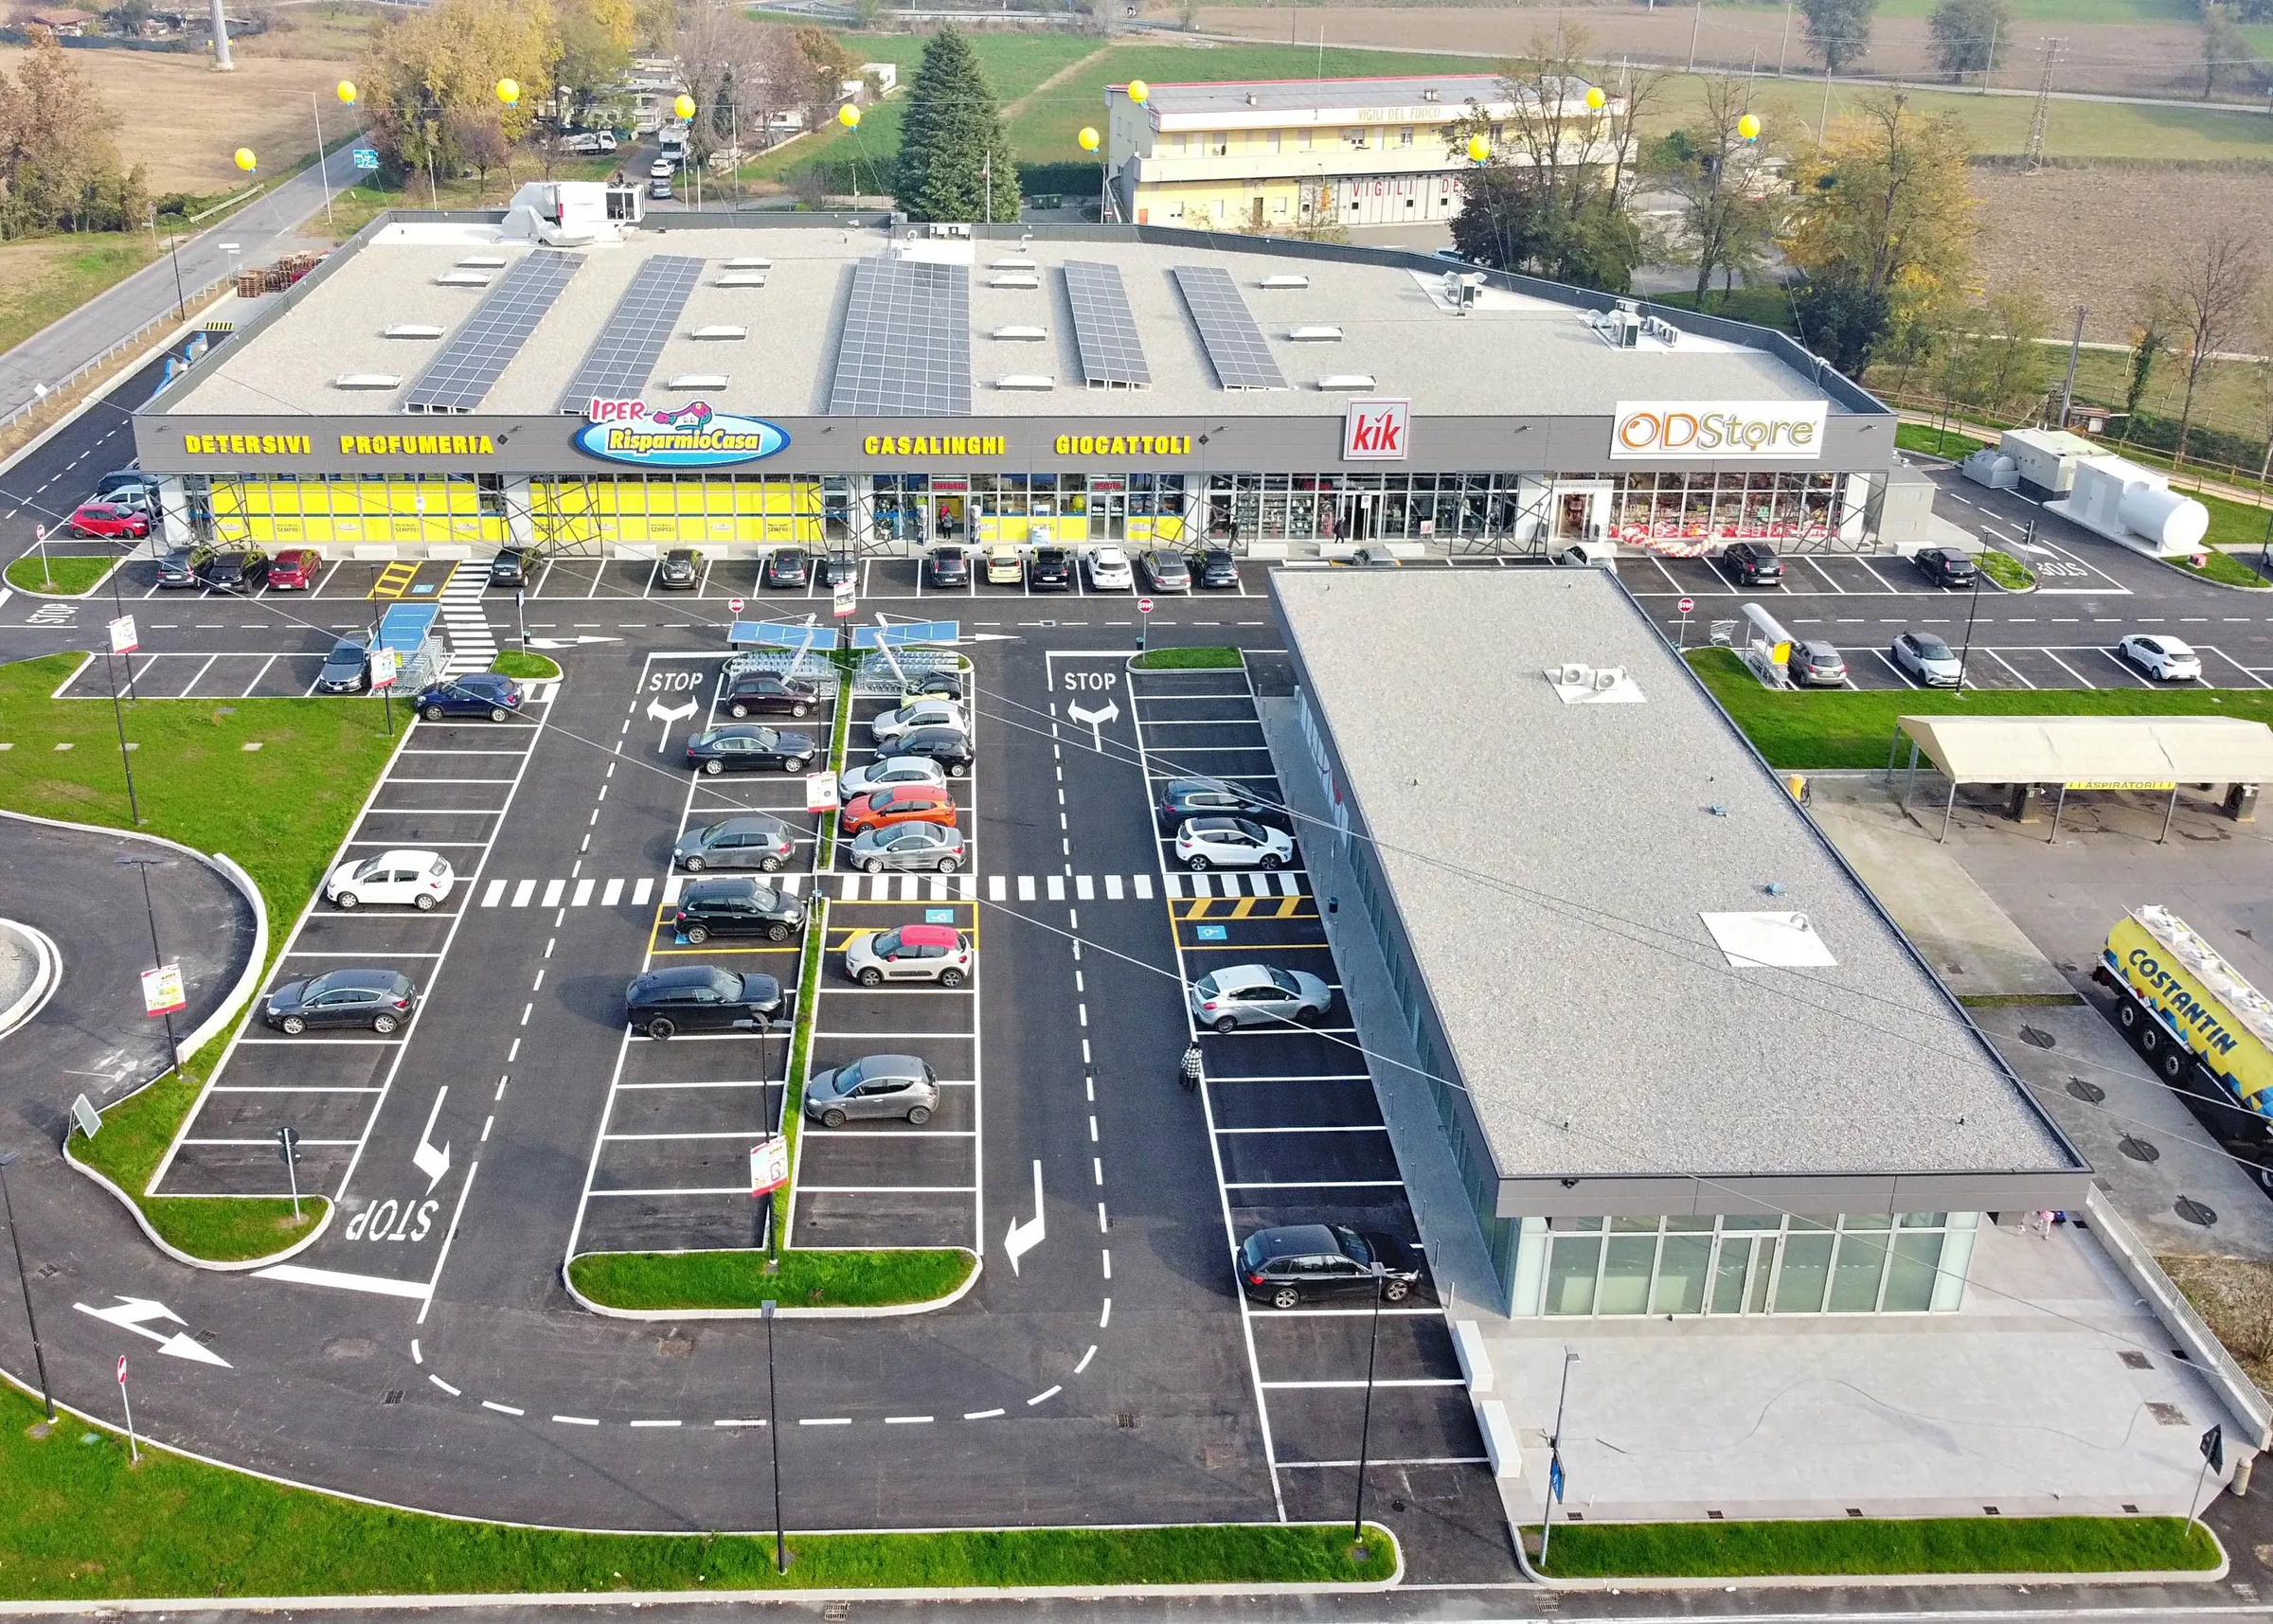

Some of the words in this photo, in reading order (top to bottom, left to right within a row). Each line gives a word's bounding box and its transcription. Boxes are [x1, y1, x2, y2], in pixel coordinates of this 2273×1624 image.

[1358, 109, 1383, 120] VIGILI
[1388, 108, 1405, 120] DEL
[1410, 106, 1441, 119] FUOCO
[1352, 179, 1413, 197] VIGILI
[1441, 178, 1459, 194] DE
[592, 399, 646, 420] IPER
[1352, 408, 1402, 451] kik
[1620, 411, 1814, 452] ODStore
[185, 435, 312, 455] DETERSIVI
[340, 435, 494, 455] PROFUMERIA
[608, 428, 761, 454] RisparmioCasa
[864, 436, 1006, 455] CASALINGHI
[1055, 435, 1191, 455] GIOCATTOLI
[26, 603, 79, 624] STOP
[649, 672, 704, 691] STOP
[1065, 672, 1117, 690] STOP
[2129, 949, 2238, 1056] COSTANTIN
[346, 1199, 439, 1242] STOP
